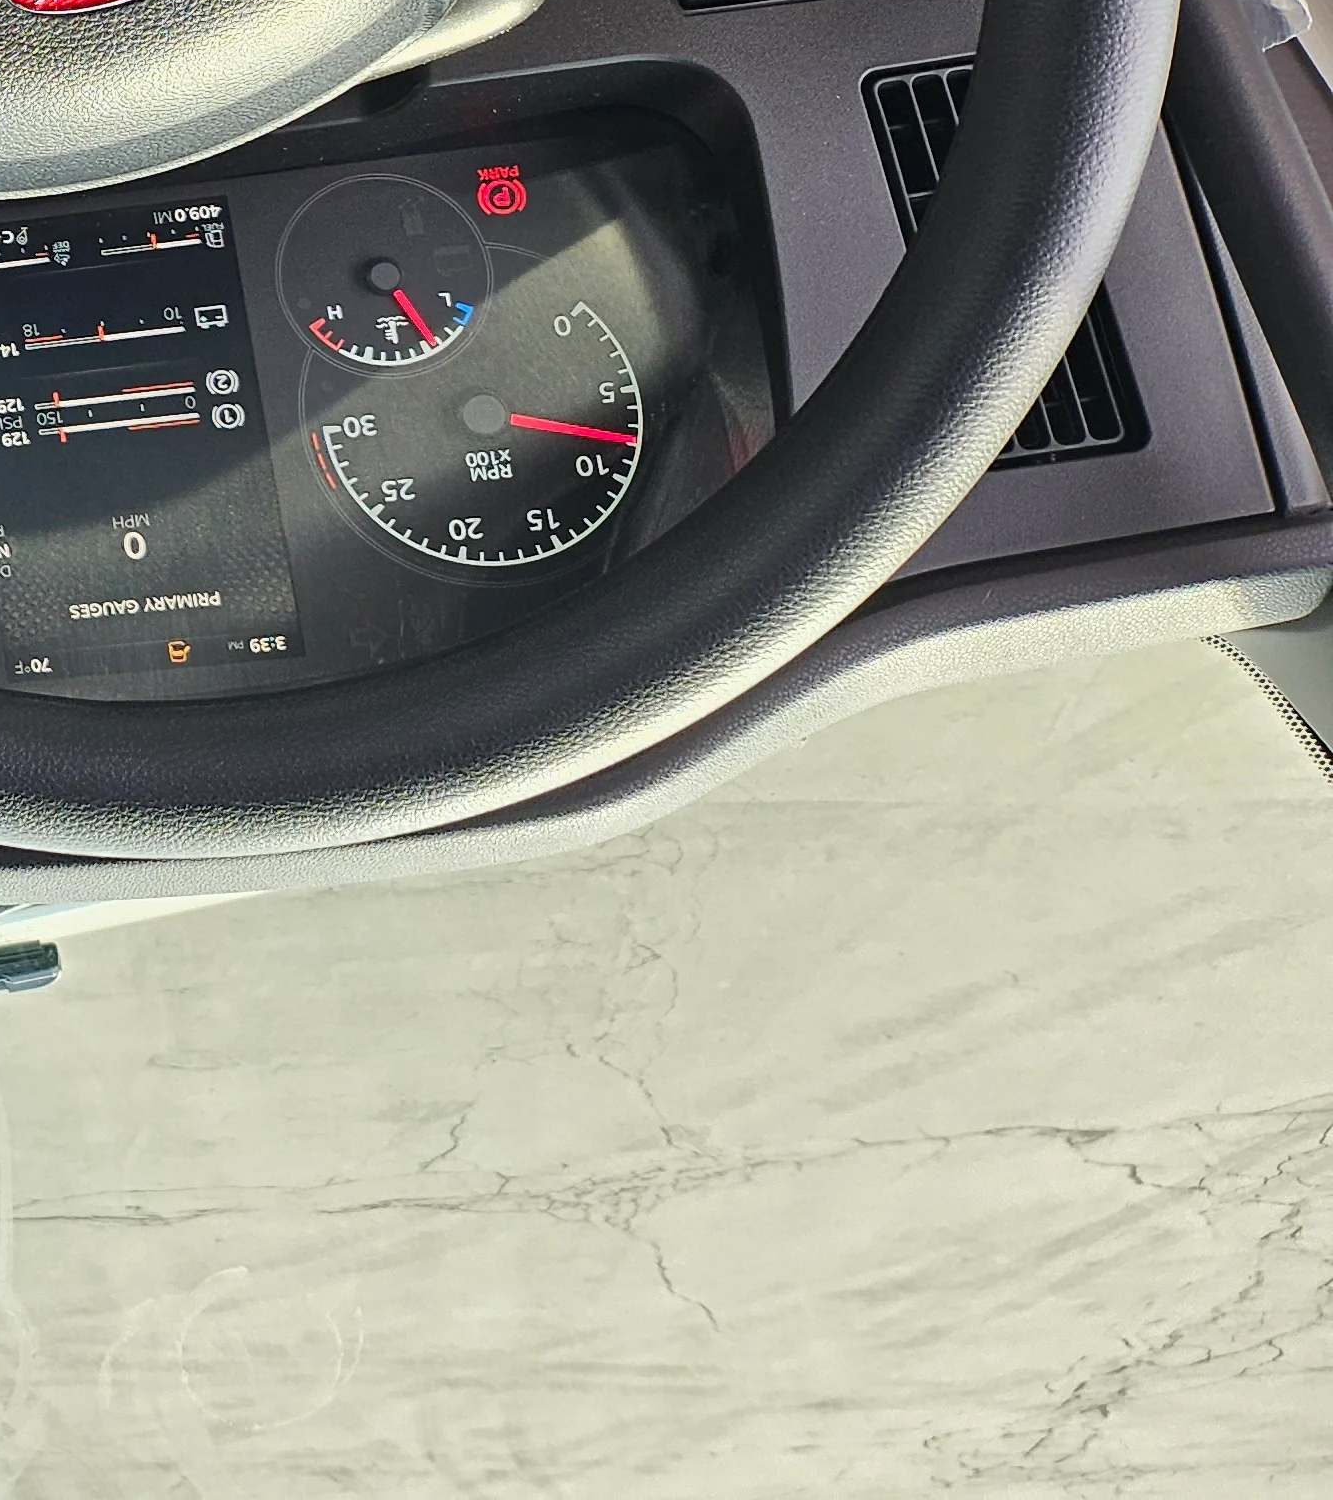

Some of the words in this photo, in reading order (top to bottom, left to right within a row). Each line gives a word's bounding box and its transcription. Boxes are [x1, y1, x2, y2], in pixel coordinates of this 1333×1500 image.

[477, 165, 519, 181] PARK
[201, 222, 225, 232] FUEL
[439, 292, 451, 307] L
[163, 306, 183, 320] 10
[327, 304, 343, 320] H
[22, 323, 40, 338] 18
[553, 314, 571, 336] 0
[599, 382, 615, 404] 5
[185, 395, 197, 409] 0
[0, 415, 23, 430] PSI
[37, 410, 63, 426] 150
[343, 414, 377, 437] 30
[1, 431, 31, 448] 129
[465, 449, 511, 468] x100
[575, 454, 609, 477] 10
[469, 464, 513, 482] RPM
[381, 478, 415, 502] 25
[111, 512, 150, 529] MPH
[449, 516, 484, 540] 20
[525, 508, 559, 531] 15
[123, 531, 147, 560] 0
[0, 564, 11, 578] D
[69, 599, 139, 620] GAUGES
[143, 590, 222, 612] PRIMARY
[227, 640, 244, 650] PM
[249, 636, 287, 653] 3:39
